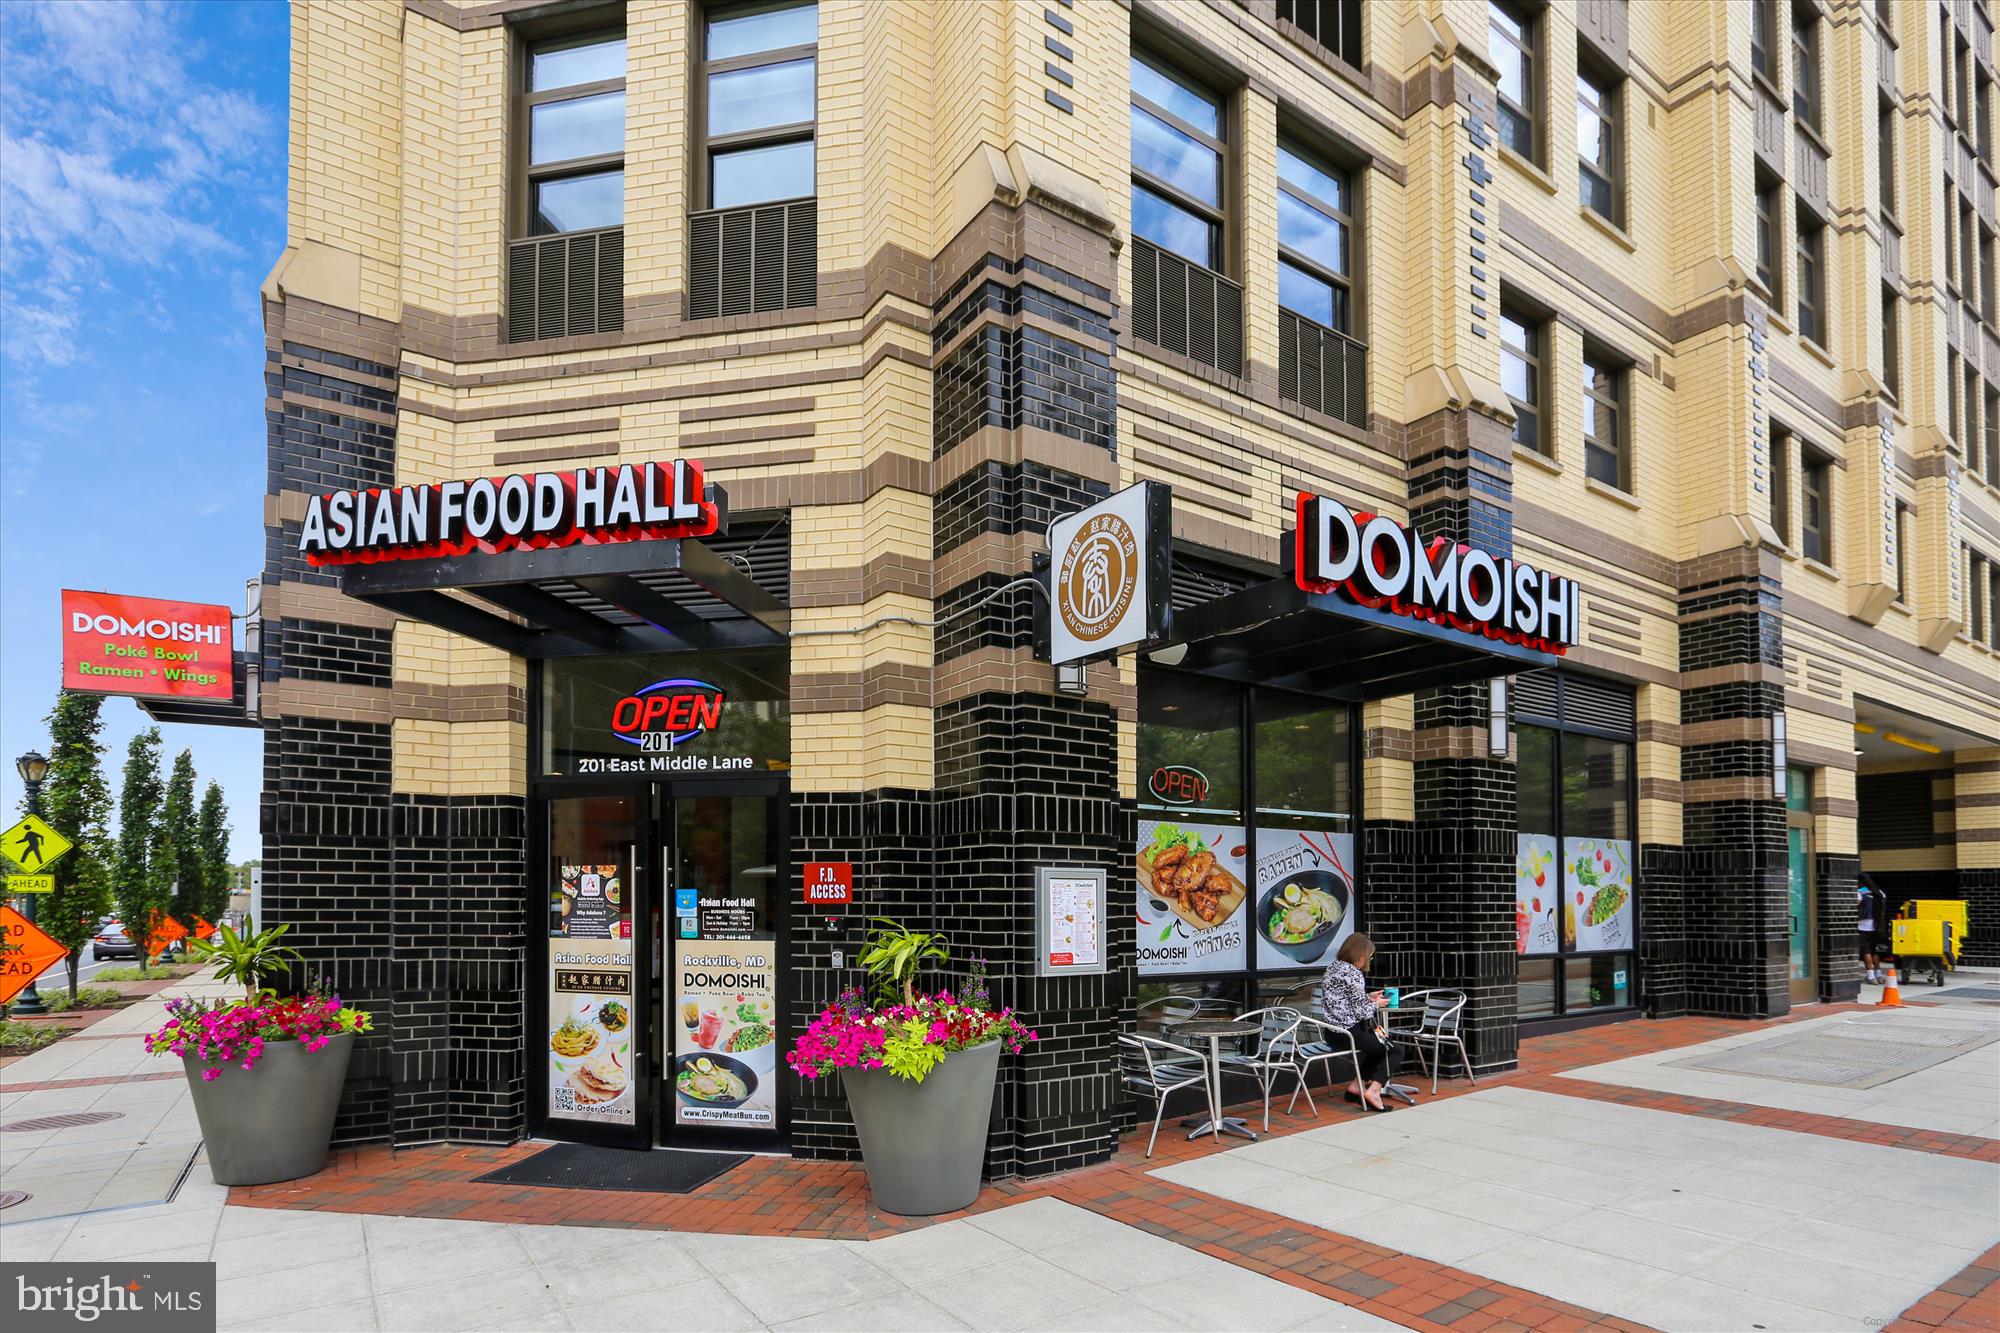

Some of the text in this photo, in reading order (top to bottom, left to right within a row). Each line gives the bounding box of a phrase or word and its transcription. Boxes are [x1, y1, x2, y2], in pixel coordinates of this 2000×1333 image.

[299, 459, 699, 550] ASIAN FOOD HALL
[1318, 495, 1580, 647] DOMOISHI
[1075, 621, 1109, 636] CHINESE
[1110, 576, 1133, 623] CUISINE
[72, 612, 221, 644] DOMOISHI
[104, 643, 199, 662] Poké Bowl
[79, 662, 217, 686] Ramen Wings
[611, 693, 723, 733] OPEN
[642, 733, 673, 751] 201
[579, 755, 753, 772] 201 East Middle Lane
[1153, 767, 1206, 802] OPEN
[819, 867, 837, 882] F.D.
[1258, 852, 1303, 885] RAMEN
[12, 879, 48, 888] AHEAD
[810, 884, 846, 899] ACCESS
[700, 897, 756, 907] Asian Food Hall
[555, 952, 582, 964] Asian
[585, 953, 609, 965] Food
[684, 954, 766, 969] Rockville, MD
[684, 972, 766, 989] DOMOISHI
[577, 1104, 623, 1115] Order Online
[683, 1109, 770, 1120] www.CrispyMeatBun.com
